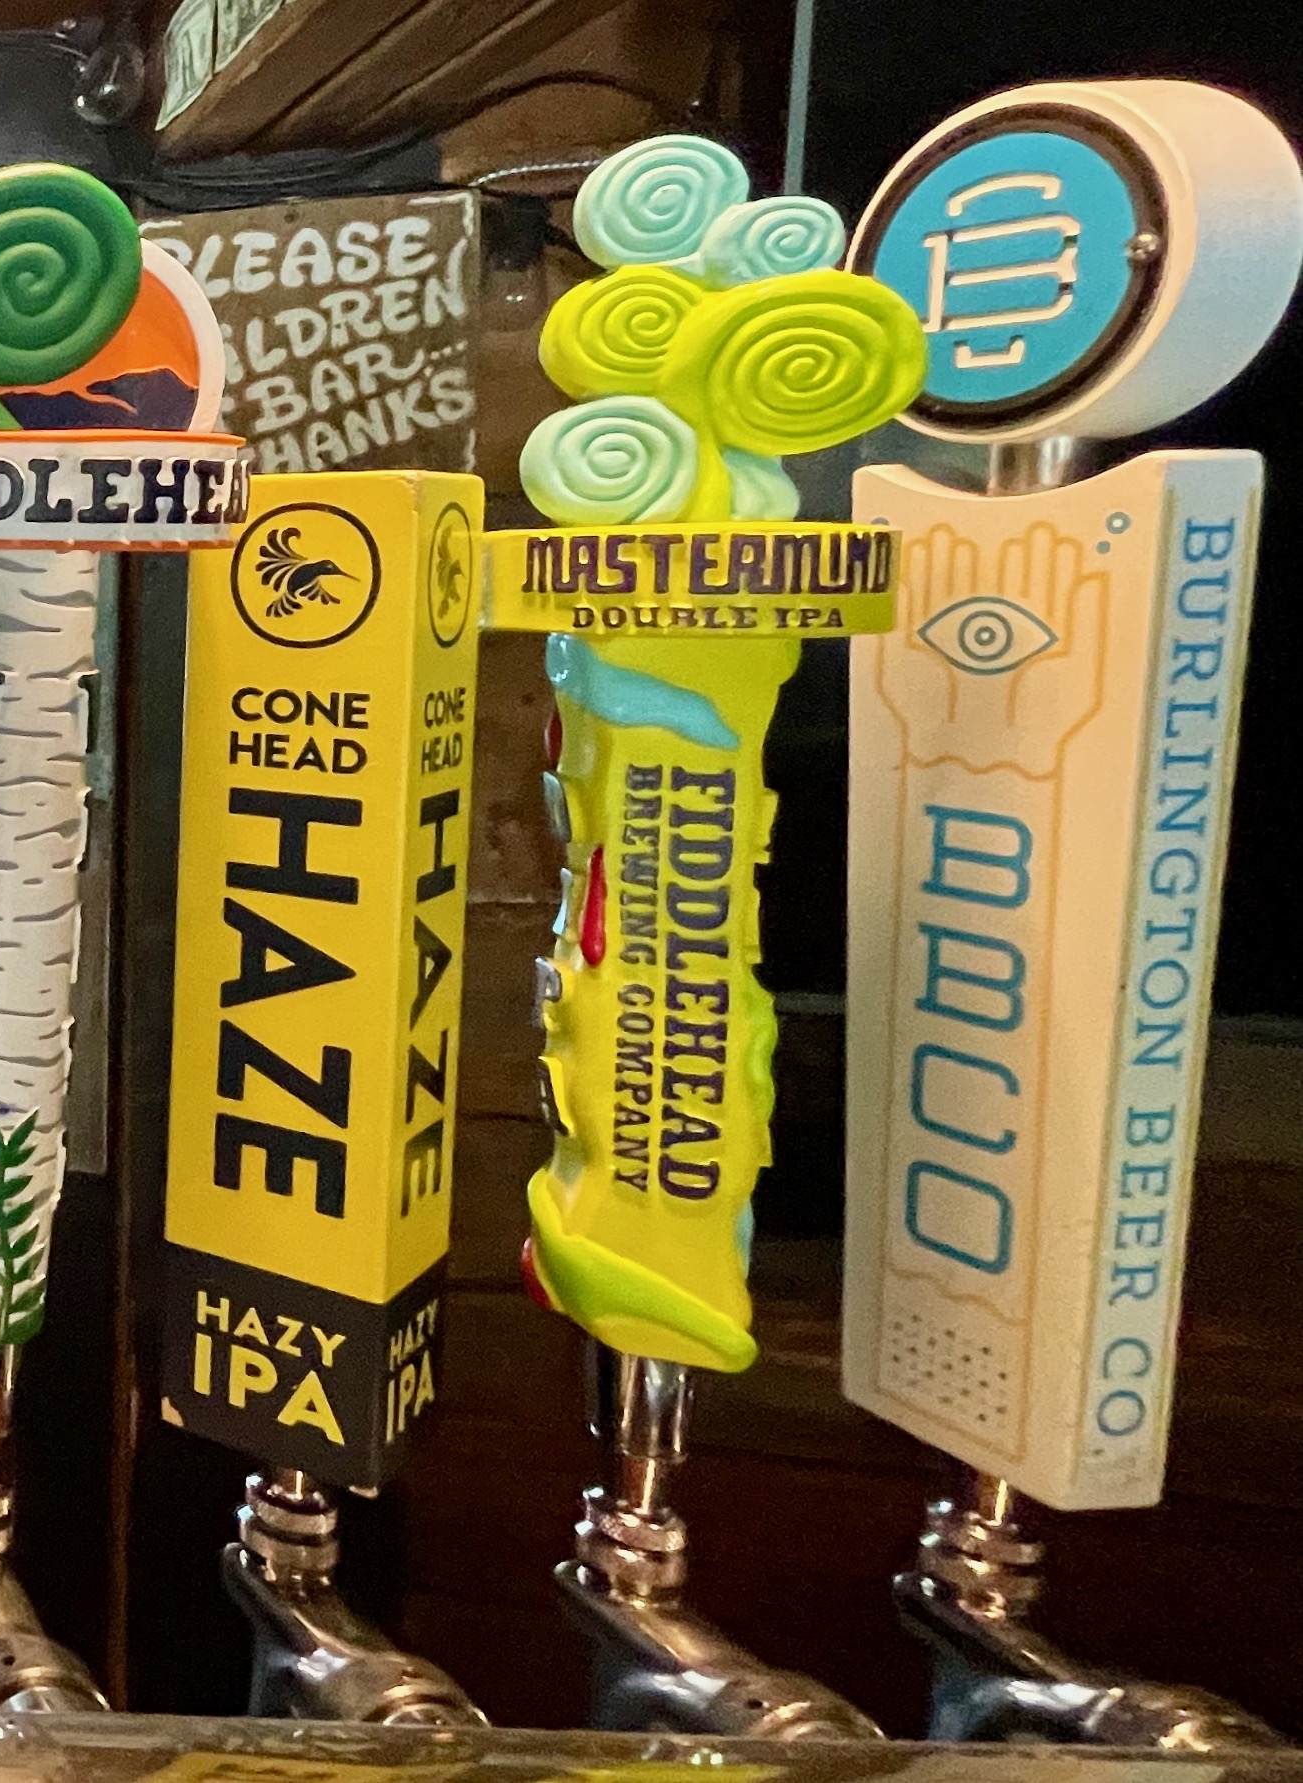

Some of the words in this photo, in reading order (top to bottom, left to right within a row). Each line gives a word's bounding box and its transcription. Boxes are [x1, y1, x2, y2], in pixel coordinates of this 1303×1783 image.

[258, 368, 476, 473] HANKS
[521, 532, 891, 595] MASTERMIND
[571, 605, 759, 629] DOUBLE
[775, 606, 845, 629] IPA
[229, 730, 369, 776] HEAD
[231, 686, 371, 731] CONE
[421, 731, 464, 777] HEAD
[423, 686, 467, 729] CONE
[1123, 516, 1236, 1071] BURLINGTON
[617, 762, 665, 966] BREWING
[213, 787, 365, 1220] HAZE
[400, 786, 461, 1219] HAZE
[657, 766, 737, 1202] FIDDLEHEAD
[611, 983, 656, 1196] COMPANY
[904, 802, 1034, 1277] BBCO
[1106, 1103, 1179, 1312] BEER
[195, 1289, 347, 1369] HAZY
[389, 1298, 440, 1373] HAZY
[192, 1333, 346, 1447] IPA
[385, 1349, 436, 1444] IPA
